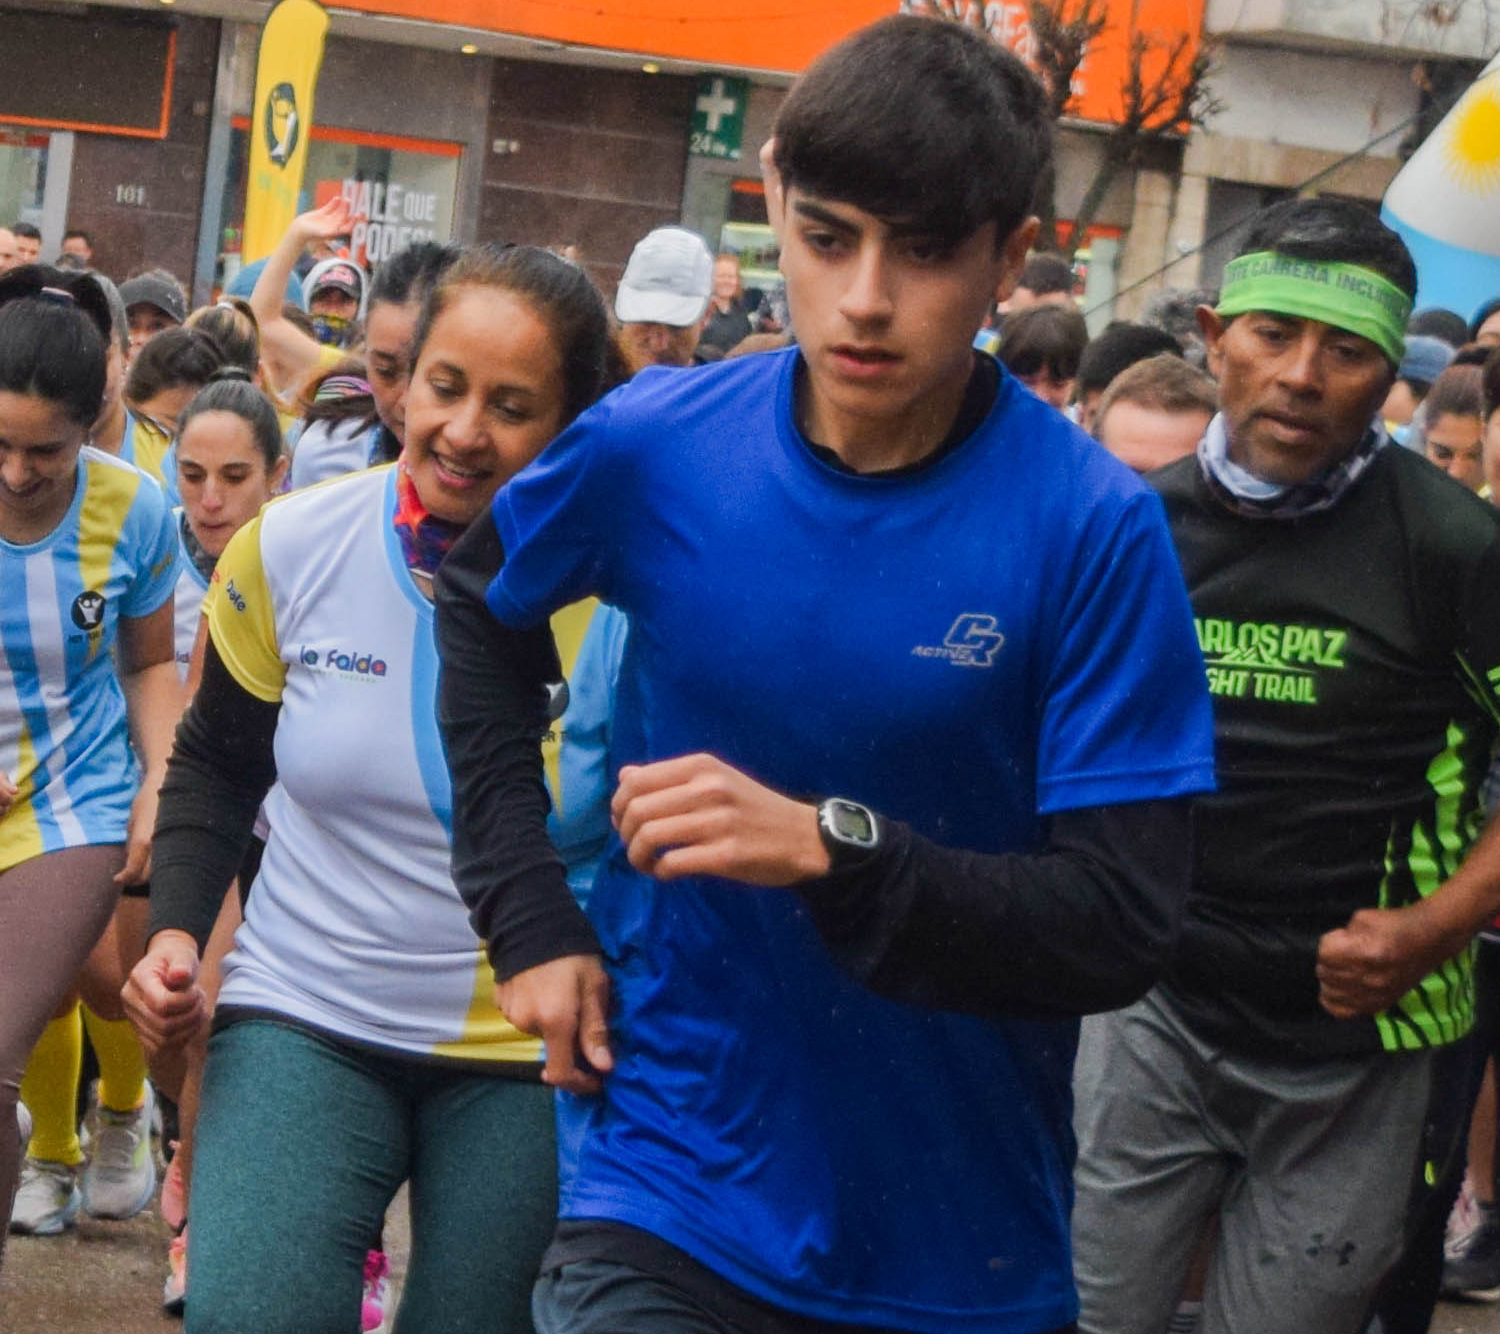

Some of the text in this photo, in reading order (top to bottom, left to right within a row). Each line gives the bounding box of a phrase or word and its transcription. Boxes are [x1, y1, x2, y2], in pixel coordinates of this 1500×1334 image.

[404, 191, 436, 221] QUE
[225, 578, 246, 612] Dale
[1193, 618, 1348, 668] ARLOS PAZ
[300, 645, 319, 665] la
[325, 649, 387, 677] falda
[1203, 667, 1318, 705] GHT TRAIL
